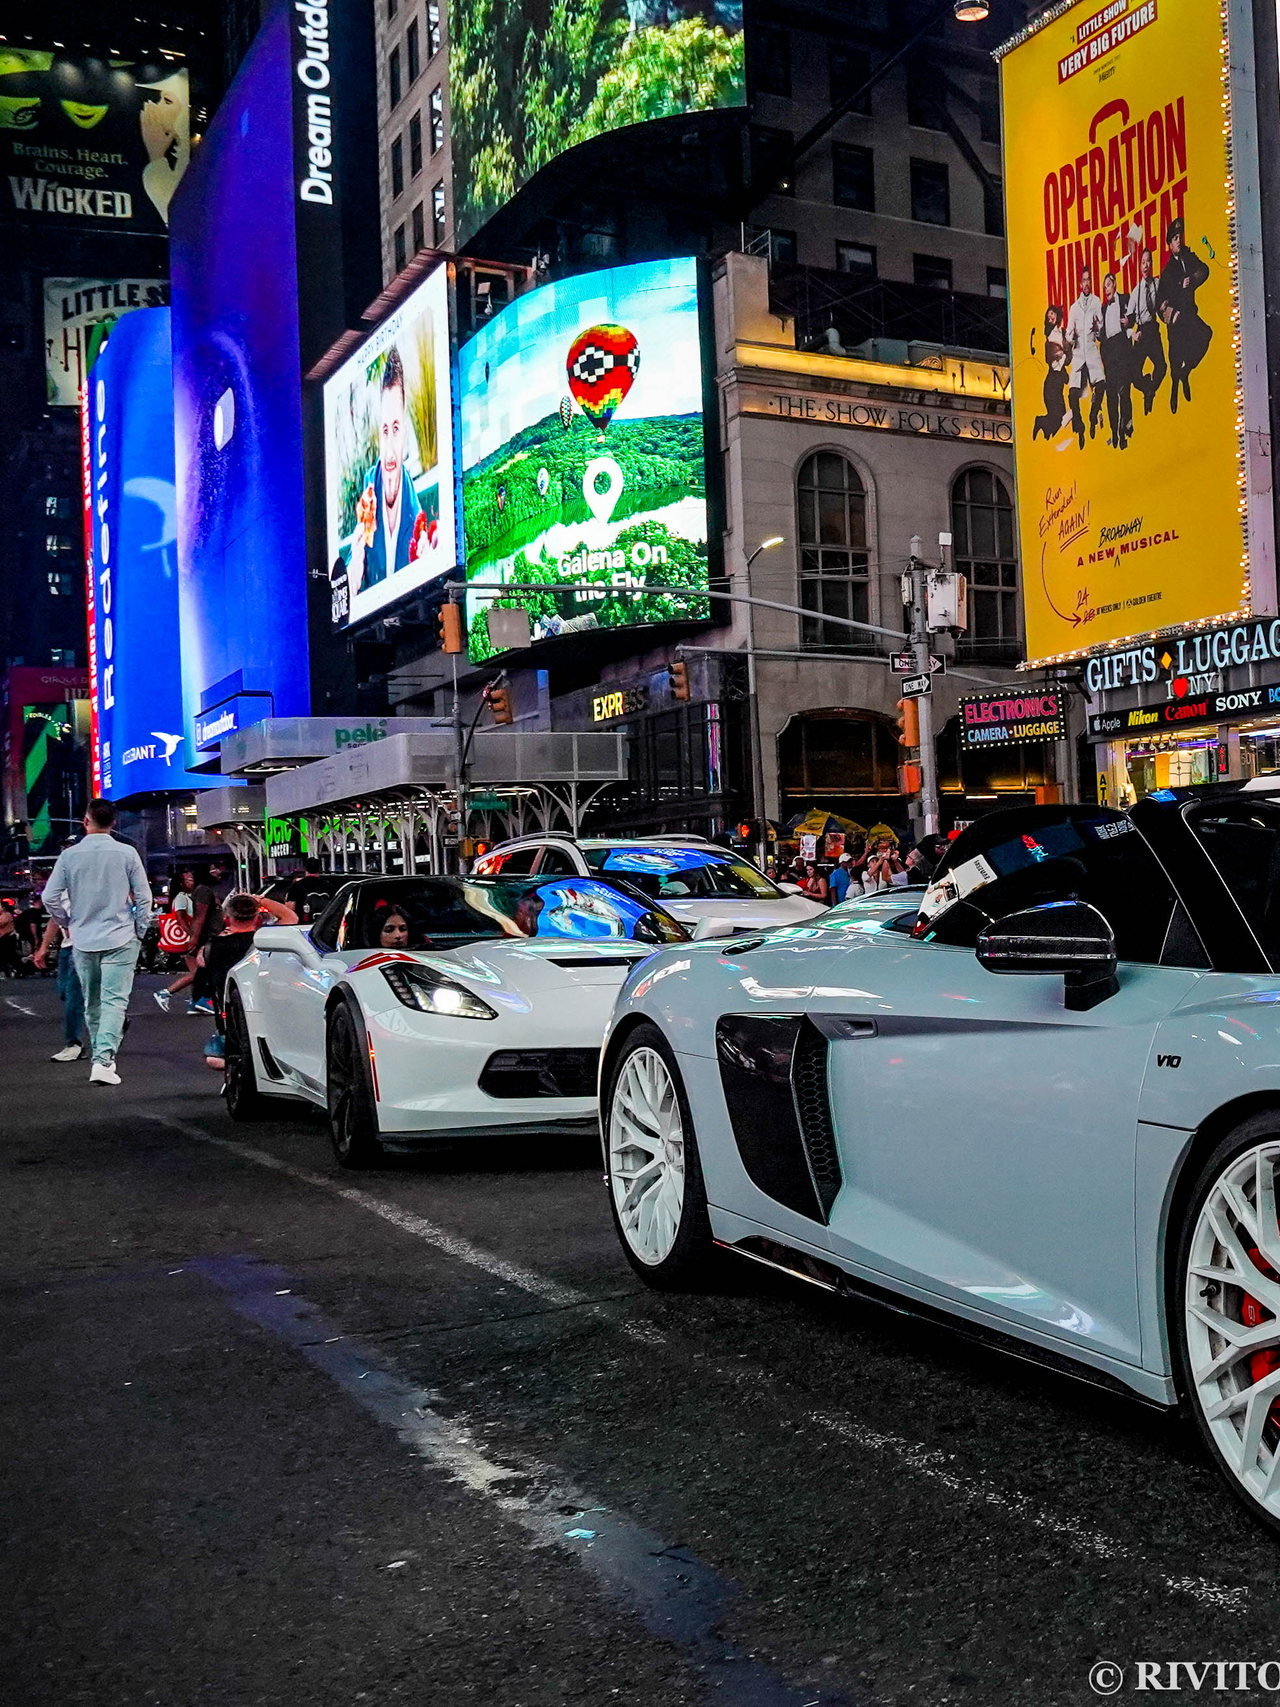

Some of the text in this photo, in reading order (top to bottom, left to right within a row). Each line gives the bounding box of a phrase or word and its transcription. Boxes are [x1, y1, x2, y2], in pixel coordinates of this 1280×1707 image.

[1078, 13, 1103, 41] LITTLE
[1103, 0, 1127, 23] SHOW
[1060, 46, 1089, 79] VERY
[1089, 32, 1110, 60] BIG
[1111, 0, 1155, 46] FUTURE
[12, 142, 128, 165] Brains. Heart.
[300, 95, 333, 205] Dream
[34, 160, 108, 179] Courage.
[1043, 95, 1188, 245] OPERATION
[62, 284, 140, 320] LITTLE
[775, 395, 1012, 442] THE SHOW FOLKS SHO
[1039, 479, 1077, 538] Extended!
[1046, 487, 1062, 510] Run
[1058, 500, 1090, 541] AGAIN!
[1099, 516, 1143, 548] BROADWAY
[97, 380, 115, 711] Redefine
[557, 541, 667, 577] Galena On
[1077, 530, 1179, 567] A NEW MUSICAL
[575, 571, 646, 602] the Fly
[1101, 604, 1112, 613] WEEKS
[1133, 596, 1146, 606] GOLDEN
[1147, 592, 1162, 602] THEATRE
[905, 680, 928, 691] ONE WAY
[1086, 646, 1159, 692] GIFTS
[1187, 672, 1219, 696] NY
[965, 695, 1058, 725] ELECTRONICS
[1101, 717, 1121, 731] Apple
[1128, 709, 1159, 727] Nikon
[1165, 701, 1209, 721] Canon
[1215, 691, 1262, 712] SONY
[335, 719, 387, 749] pelé
[968, 721, 1060, 742] CAMERA LUGGAGE
[1156, 1054, 1182, 1069] V10
